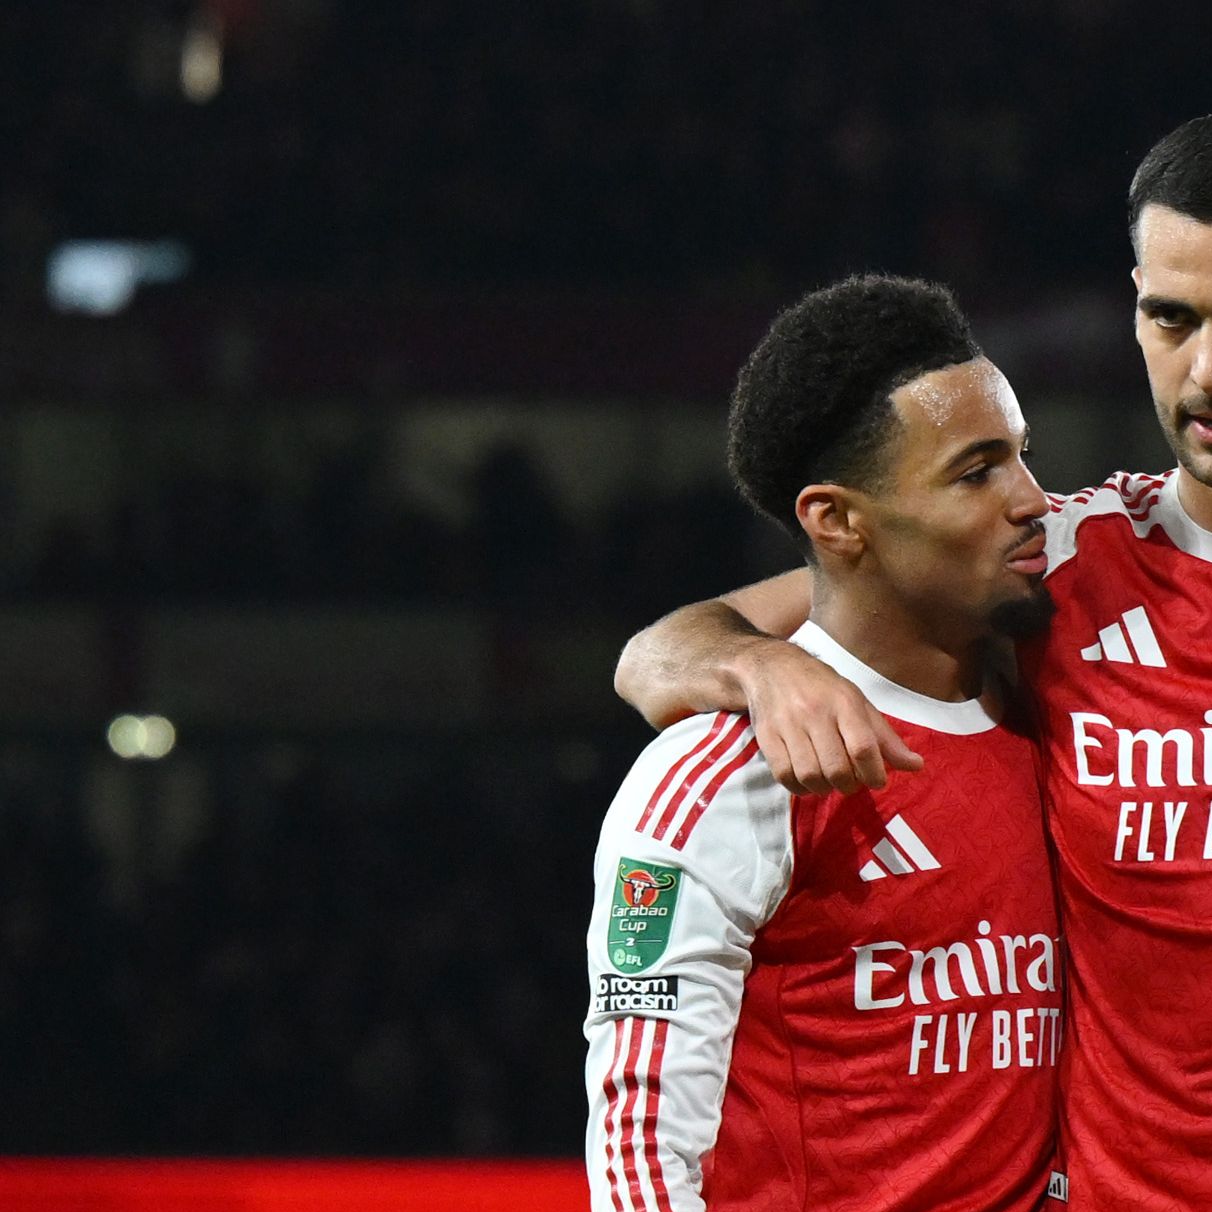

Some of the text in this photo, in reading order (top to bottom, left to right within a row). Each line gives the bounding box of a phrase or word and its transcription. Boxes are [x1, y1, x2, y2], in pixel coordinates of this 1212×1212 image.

[1114, 801, 1188, 862] FLY
[611, 904, 668, 917] Carabao
[619, 918, 647, 933] Cup
[625, 937, 635, 946] 2
[626, 954, 642, 966] EFL
[851, 920, 1063, 1010] Emira
[611, 977, 668, 994] room
[610, 993, 677, 1011] racism
[908, 1008, 1063, 1075] FLY BETT
